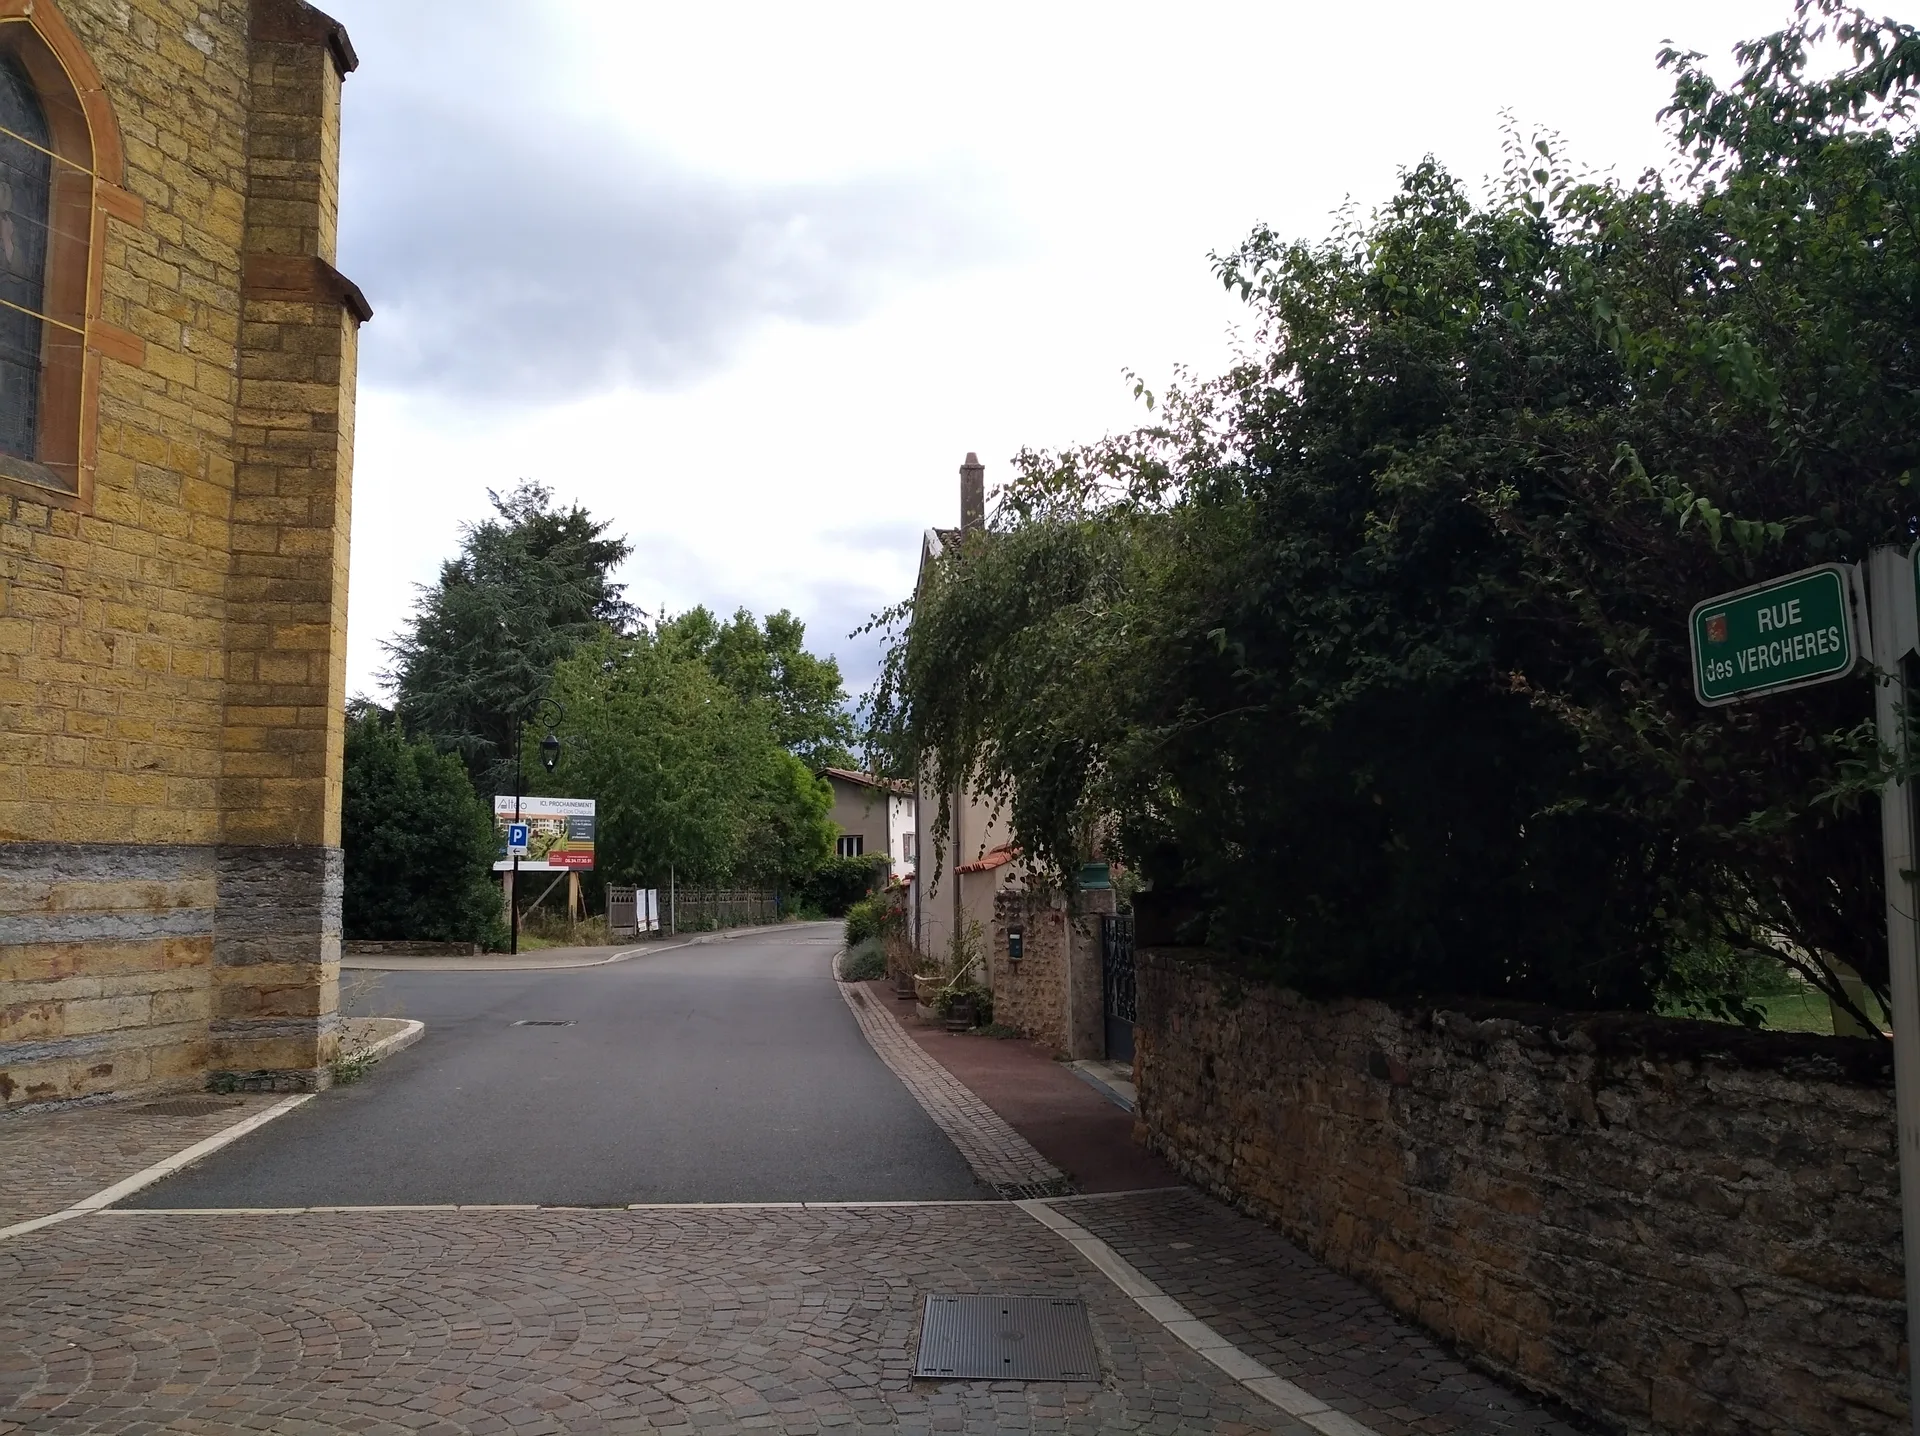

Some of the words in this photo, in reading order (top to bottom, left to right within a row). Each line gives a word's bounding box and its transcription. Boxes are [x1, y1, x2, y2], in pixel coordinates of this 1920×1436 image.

[1757, 598, 1803, 634] RUE
[1706, 658, 1733, 682] des
[1736, 625, 1840, 674] VERCHERES
[514, 829, 522, 842] P
